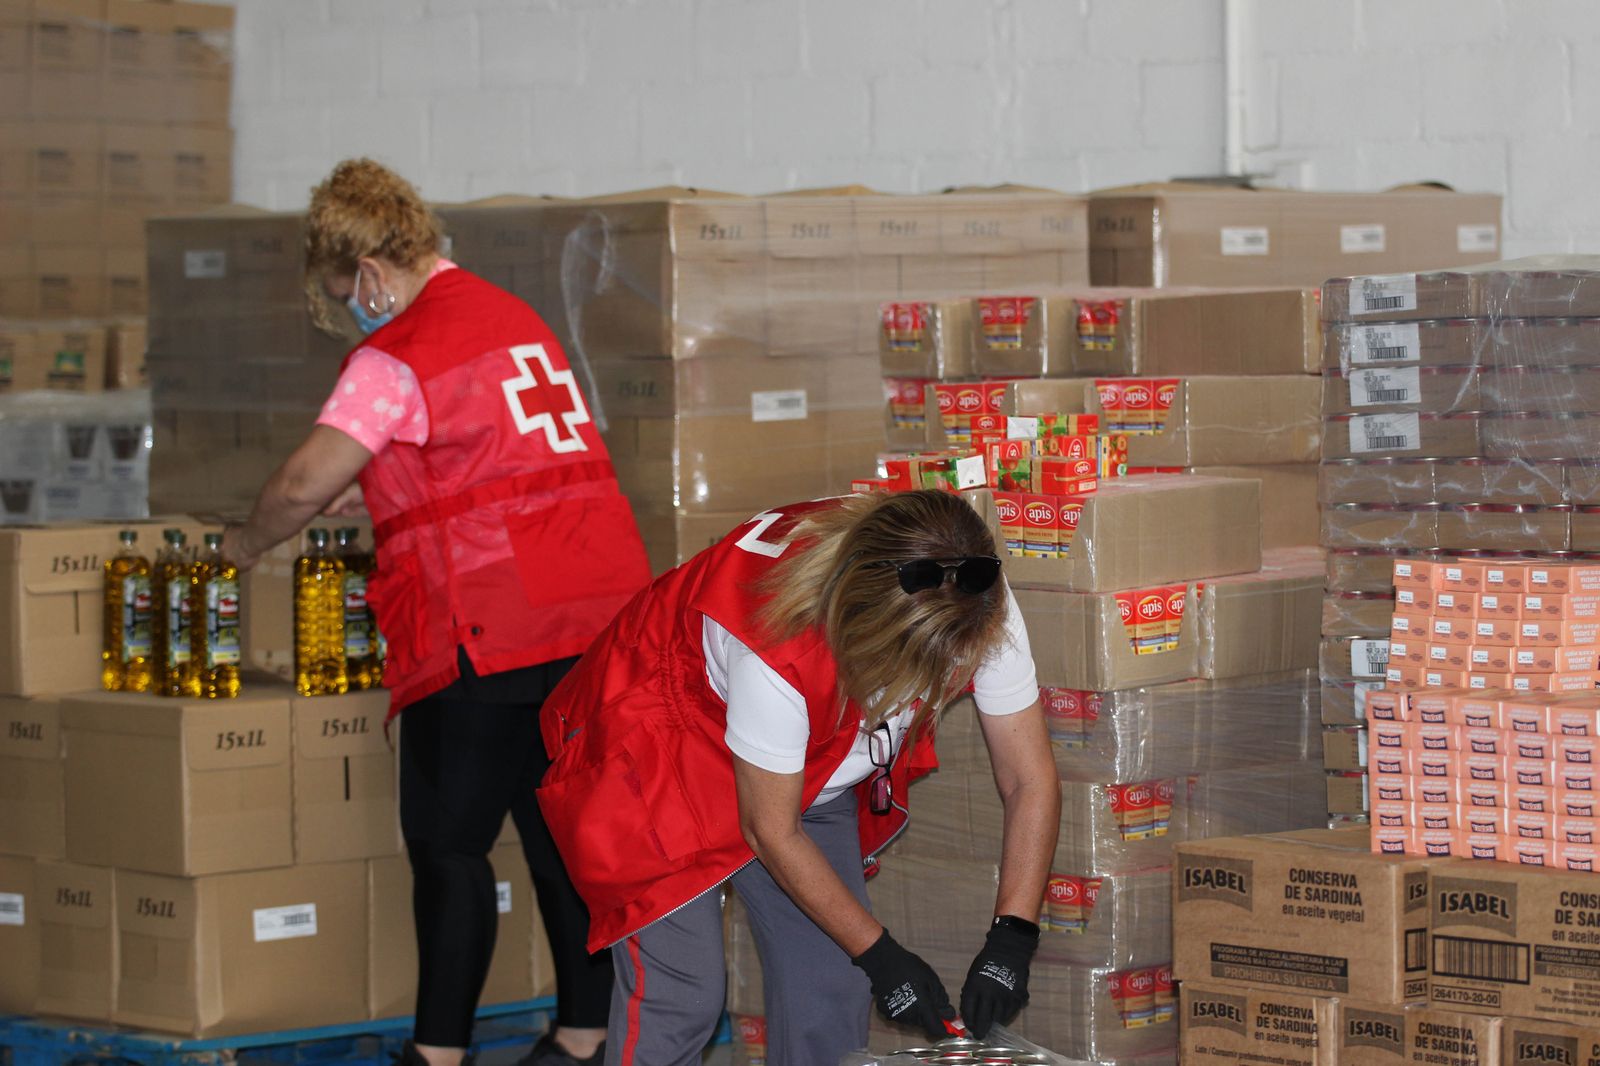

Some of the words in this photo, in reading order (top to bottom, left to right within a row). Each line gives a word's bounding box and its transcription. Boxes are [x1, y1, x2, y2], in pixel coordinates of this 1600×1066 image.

[958, 394, 980, 409] apis
[1100, 389, 1116, 404] pis
[1125, 389, 1148, 405] apis
[1029, 504, 1052, 525] apis
[1063, 505, 1081, 524] api
[51, 554, 101, 575] 15x1L
[1142, 600, 1162, 616] apis
[1051, 694, 1075, 711] apis
[321, 717, 370, 738] 15x1L
[216, 729, 267, 751] 15x1L
[1129, 787, 1150, 803] apis
[1185, 868, 1247, 894] ISABEL
[1289, 868, 1358, 889] CONSERVA
[1050, 883, 1073, 898] apis
[1285, 884, 1301, 900] DE
[1304, 887, 1363, 906] SARDINA
[136, 896, 177, 918] 15x1L
[1440, 892, 1510, 919] ISABEL
[1560, 891, 1600, 910] CONS
[1282, 904, 1295, 916] en
[1296, 904, 1326, 919] aceite
[1328, 908, 1365, 924] vegetal
[1554, 909, 1573, 925] DE
[1551, 929, 1565, 941] en
[1132, 974, 1152, 989] apis
[1224, 966, 1281, 984] PROHIBIDA
[1283, 974, 1297, 986] SU
[1300, 975, 1336, 991] VENTA
[1546, 964, 1599, 980] PROHIBIDA
[1434, 987, 1499, 1005] 264170-20-00
[1193, 1002, 1243, 1023] ISABEL
[1260, 1002, 1314, 1020] CONSERVA
[1256, 1015, 1270, 1029] DE
[1273, 1018, 1319, 1034] SARDINA
[1350, 1020, 1400, 1043] ISABEL
[1254, 1032, 1265, 1041] en
[1266, 1033, 1290, 1044] aceite
[1415, 1035, 1429, 1049] DE
[1431, 1038, 1479, 1057] SARDNA
[1413, 1052, 1423, 1061] en
[1425, 1052, 1449, 1065] aceite
[1519, 1043, 1572, 1065] ISABEL
